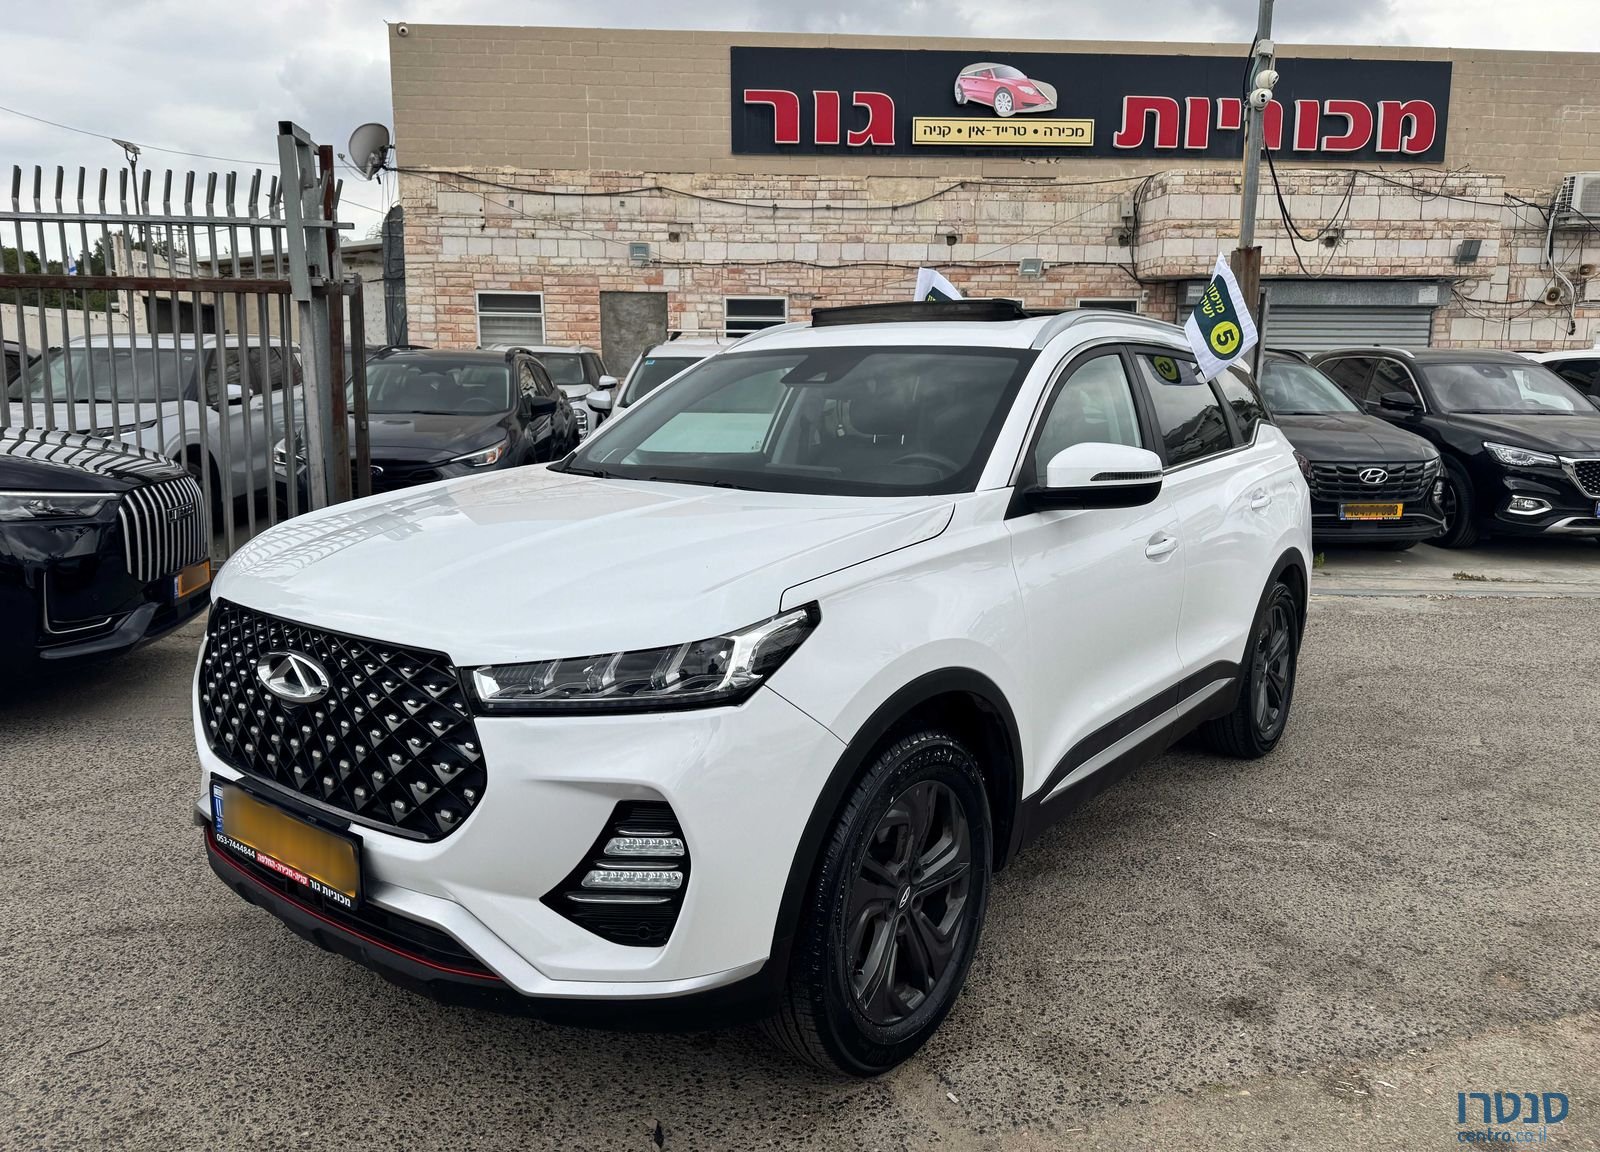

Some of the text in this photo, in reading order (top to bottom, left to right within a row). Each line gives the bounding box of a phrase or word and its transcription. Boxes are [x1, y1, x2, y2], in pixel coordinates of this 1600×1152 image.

[744, 89, 1437, 154] מכוניות גור
[923, 125, 1085, 140] מכירה טרייד-אין קניה
[1216, 328, 1235, 347] 5
[216, 833, 256, 859] 053-7444844
[309, 879, 321, 892] גור
[322, 885, 351, 908] מכוניות
